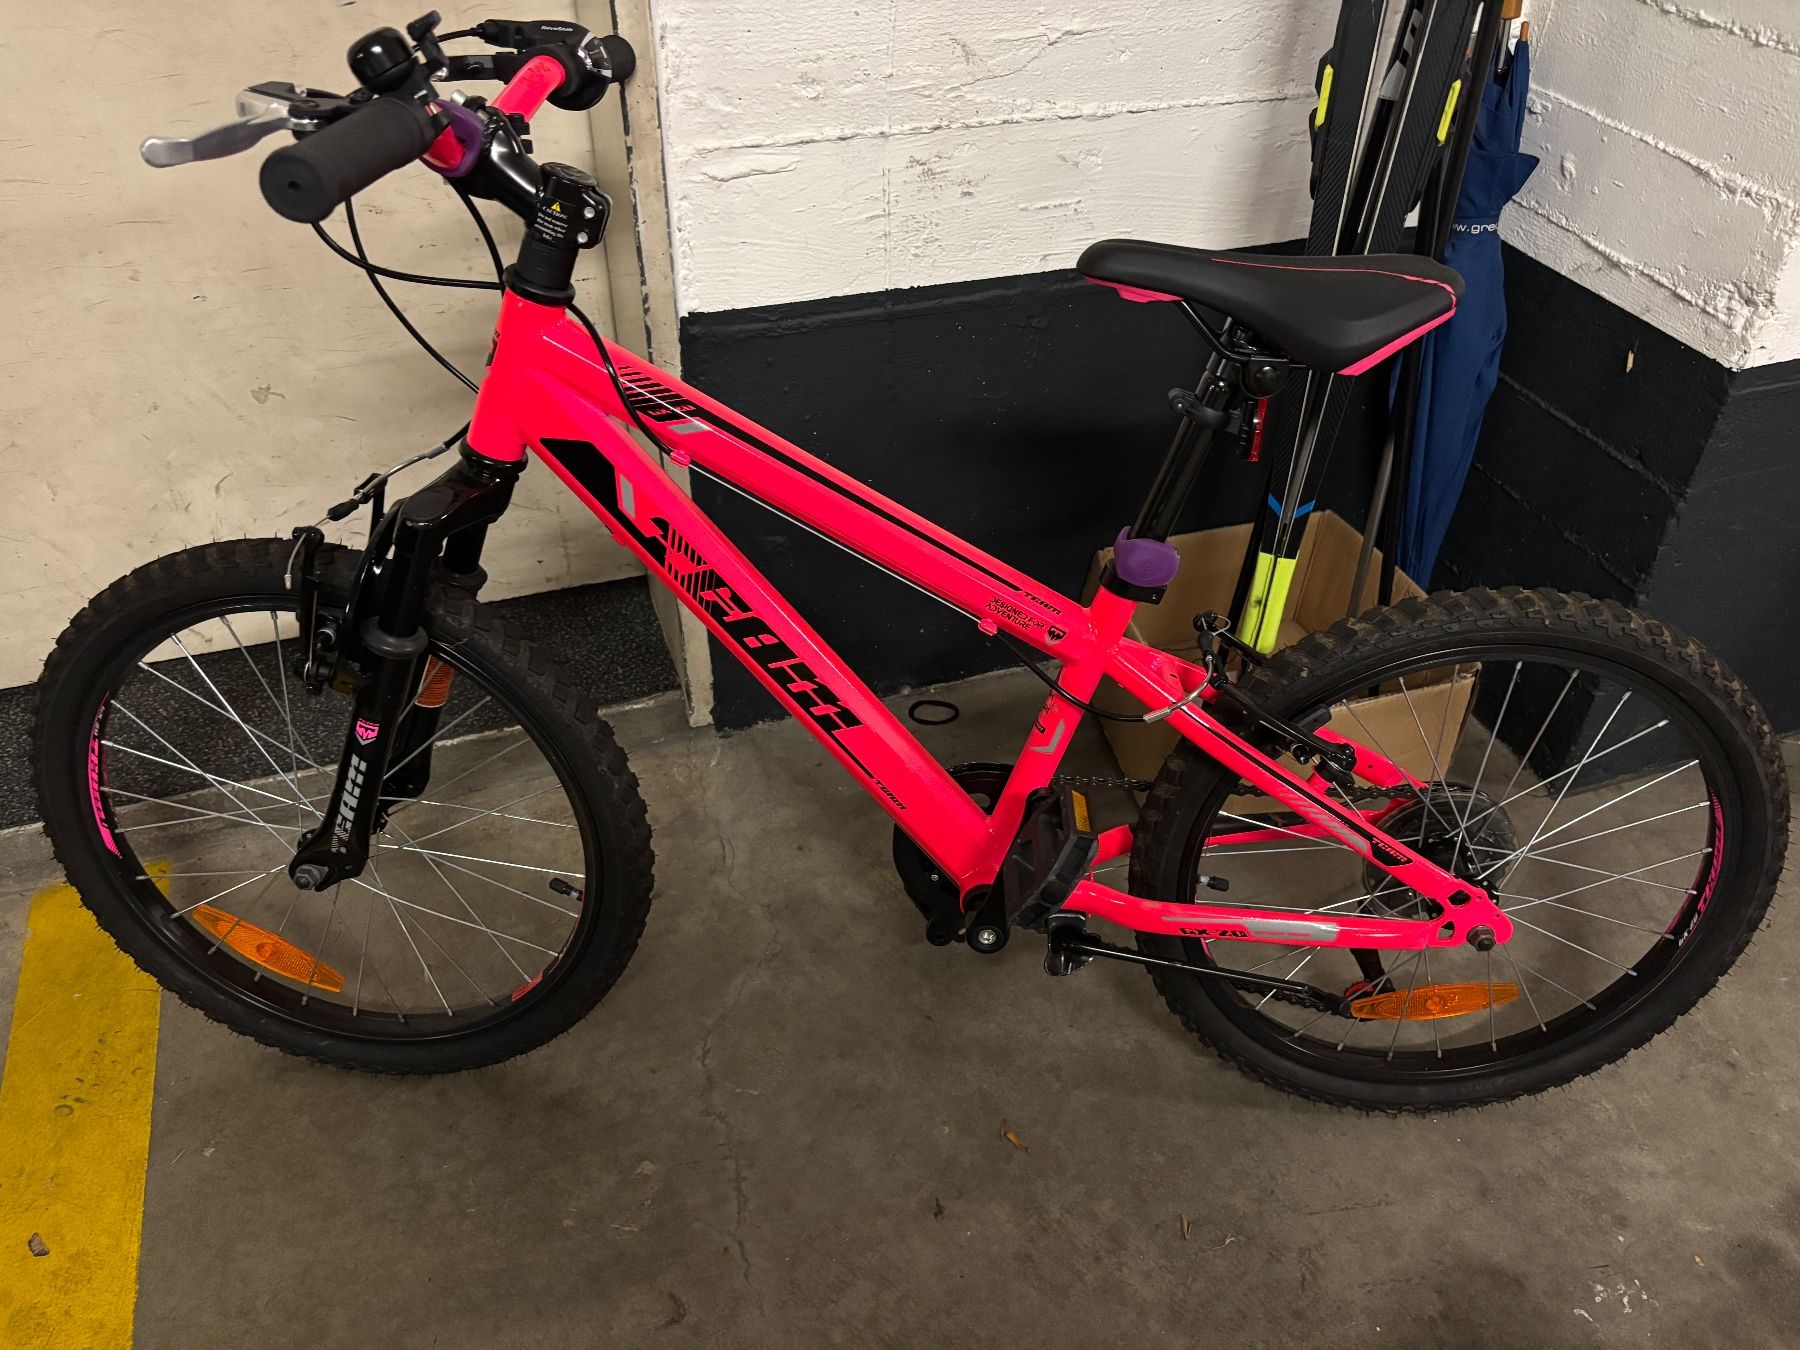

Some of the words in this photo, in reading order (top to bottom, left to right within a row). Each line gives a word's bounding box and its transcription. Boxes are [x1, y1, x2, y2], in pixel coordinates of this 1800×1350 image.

[986, 604, 1032, 630] ADVENTURE
[991, 597, 1028, 618] DESIGNED
[1029, 615, 1045, 631] FOR
